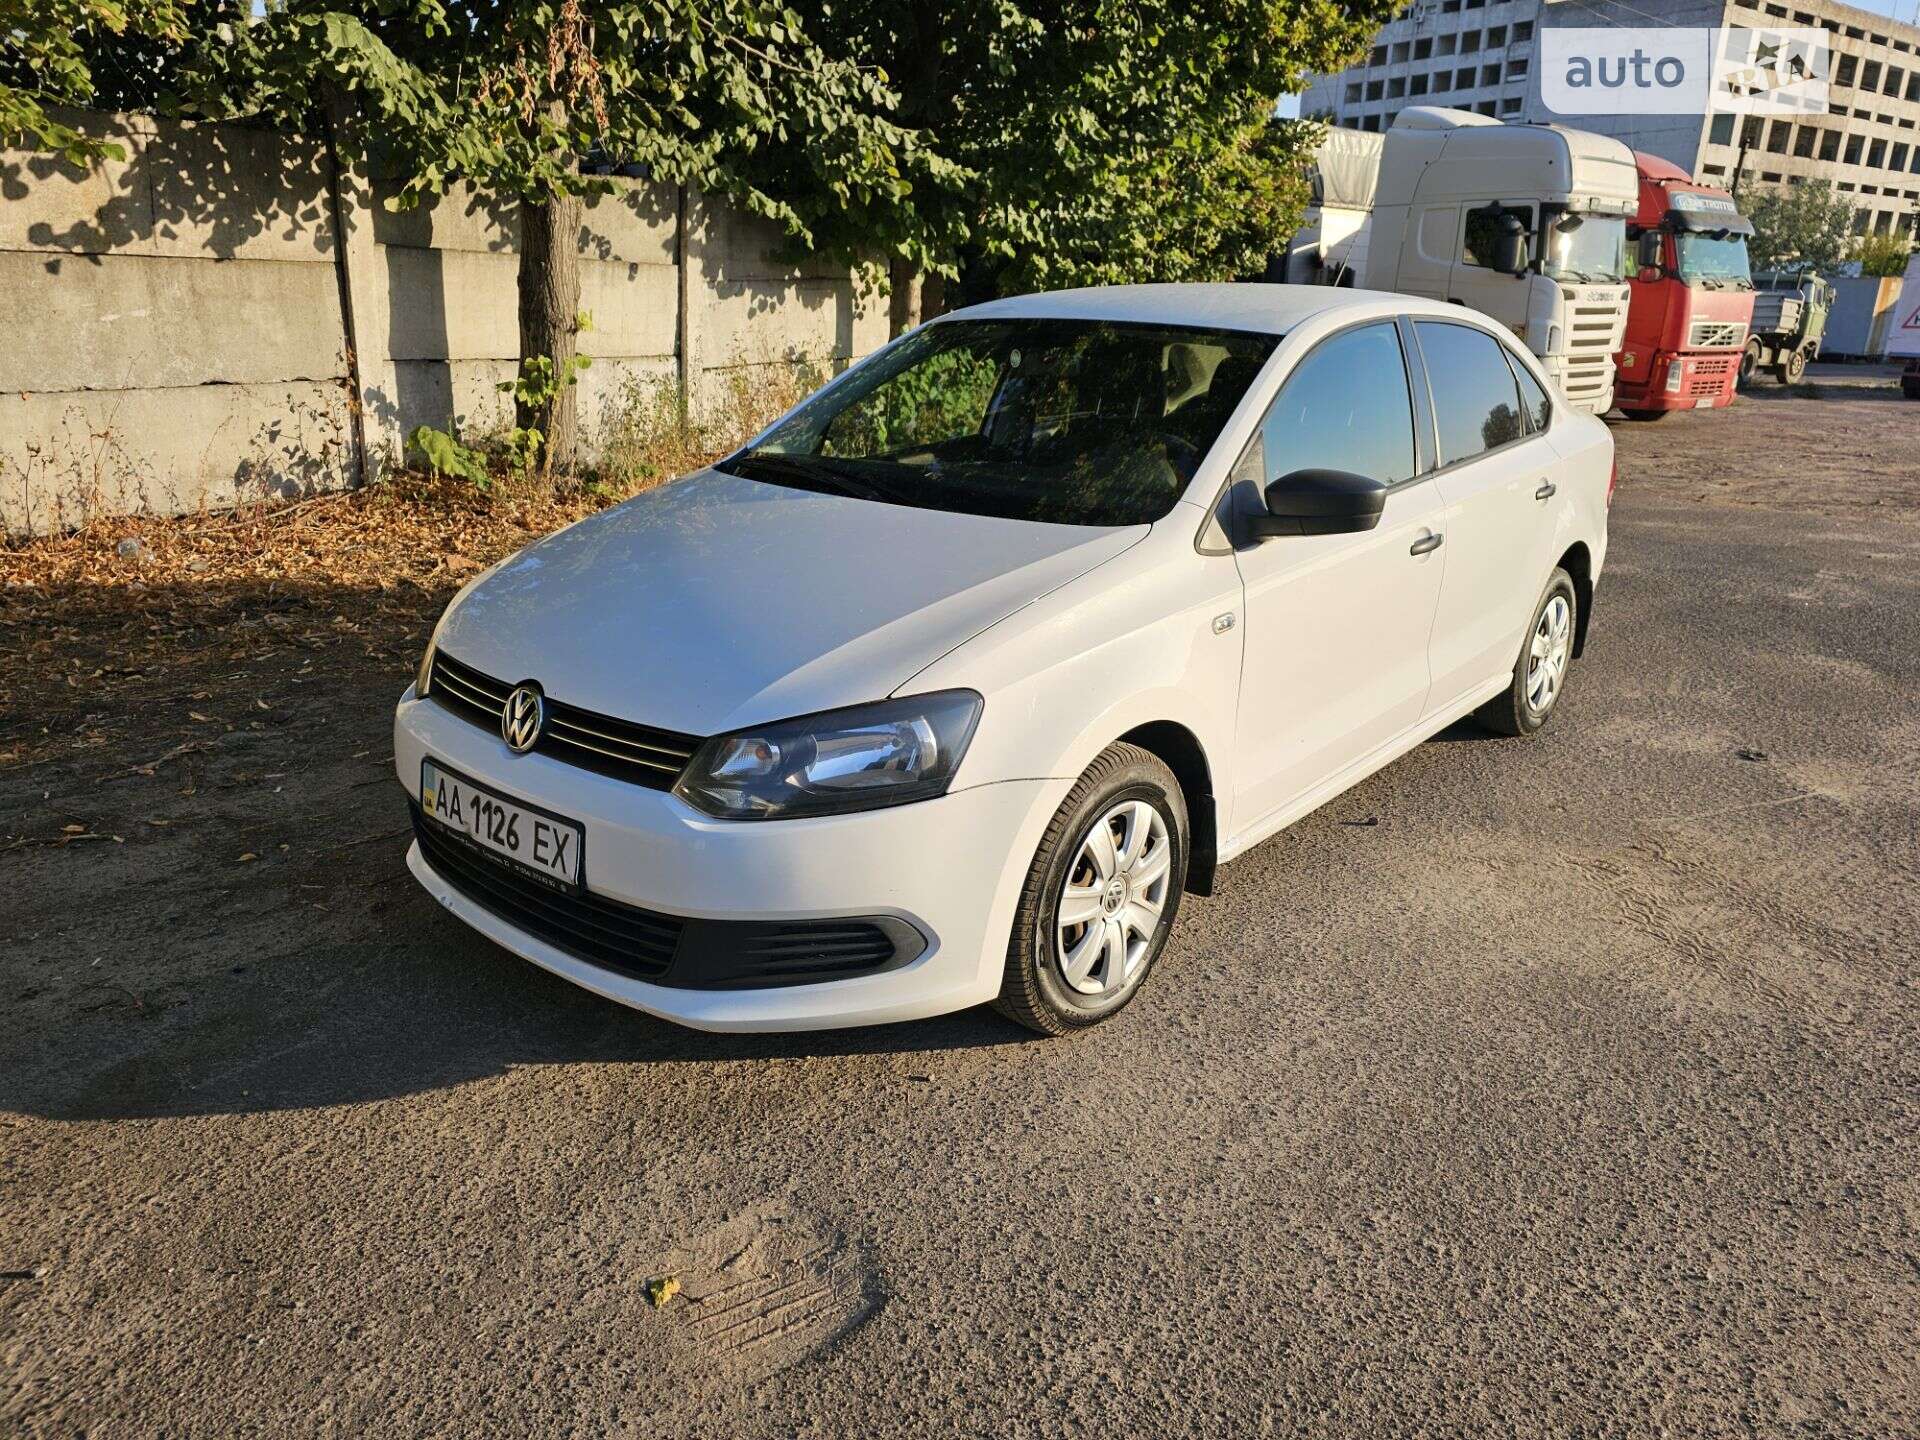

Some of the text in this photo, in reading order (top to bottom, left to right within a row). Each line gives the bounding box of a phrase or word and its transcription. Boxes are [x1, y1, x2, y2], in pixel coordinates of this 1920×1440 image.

[436, 777, 464, 825] AA
[470, 794, 520, 852] 1126
[533, 820, 570, 874] EX
